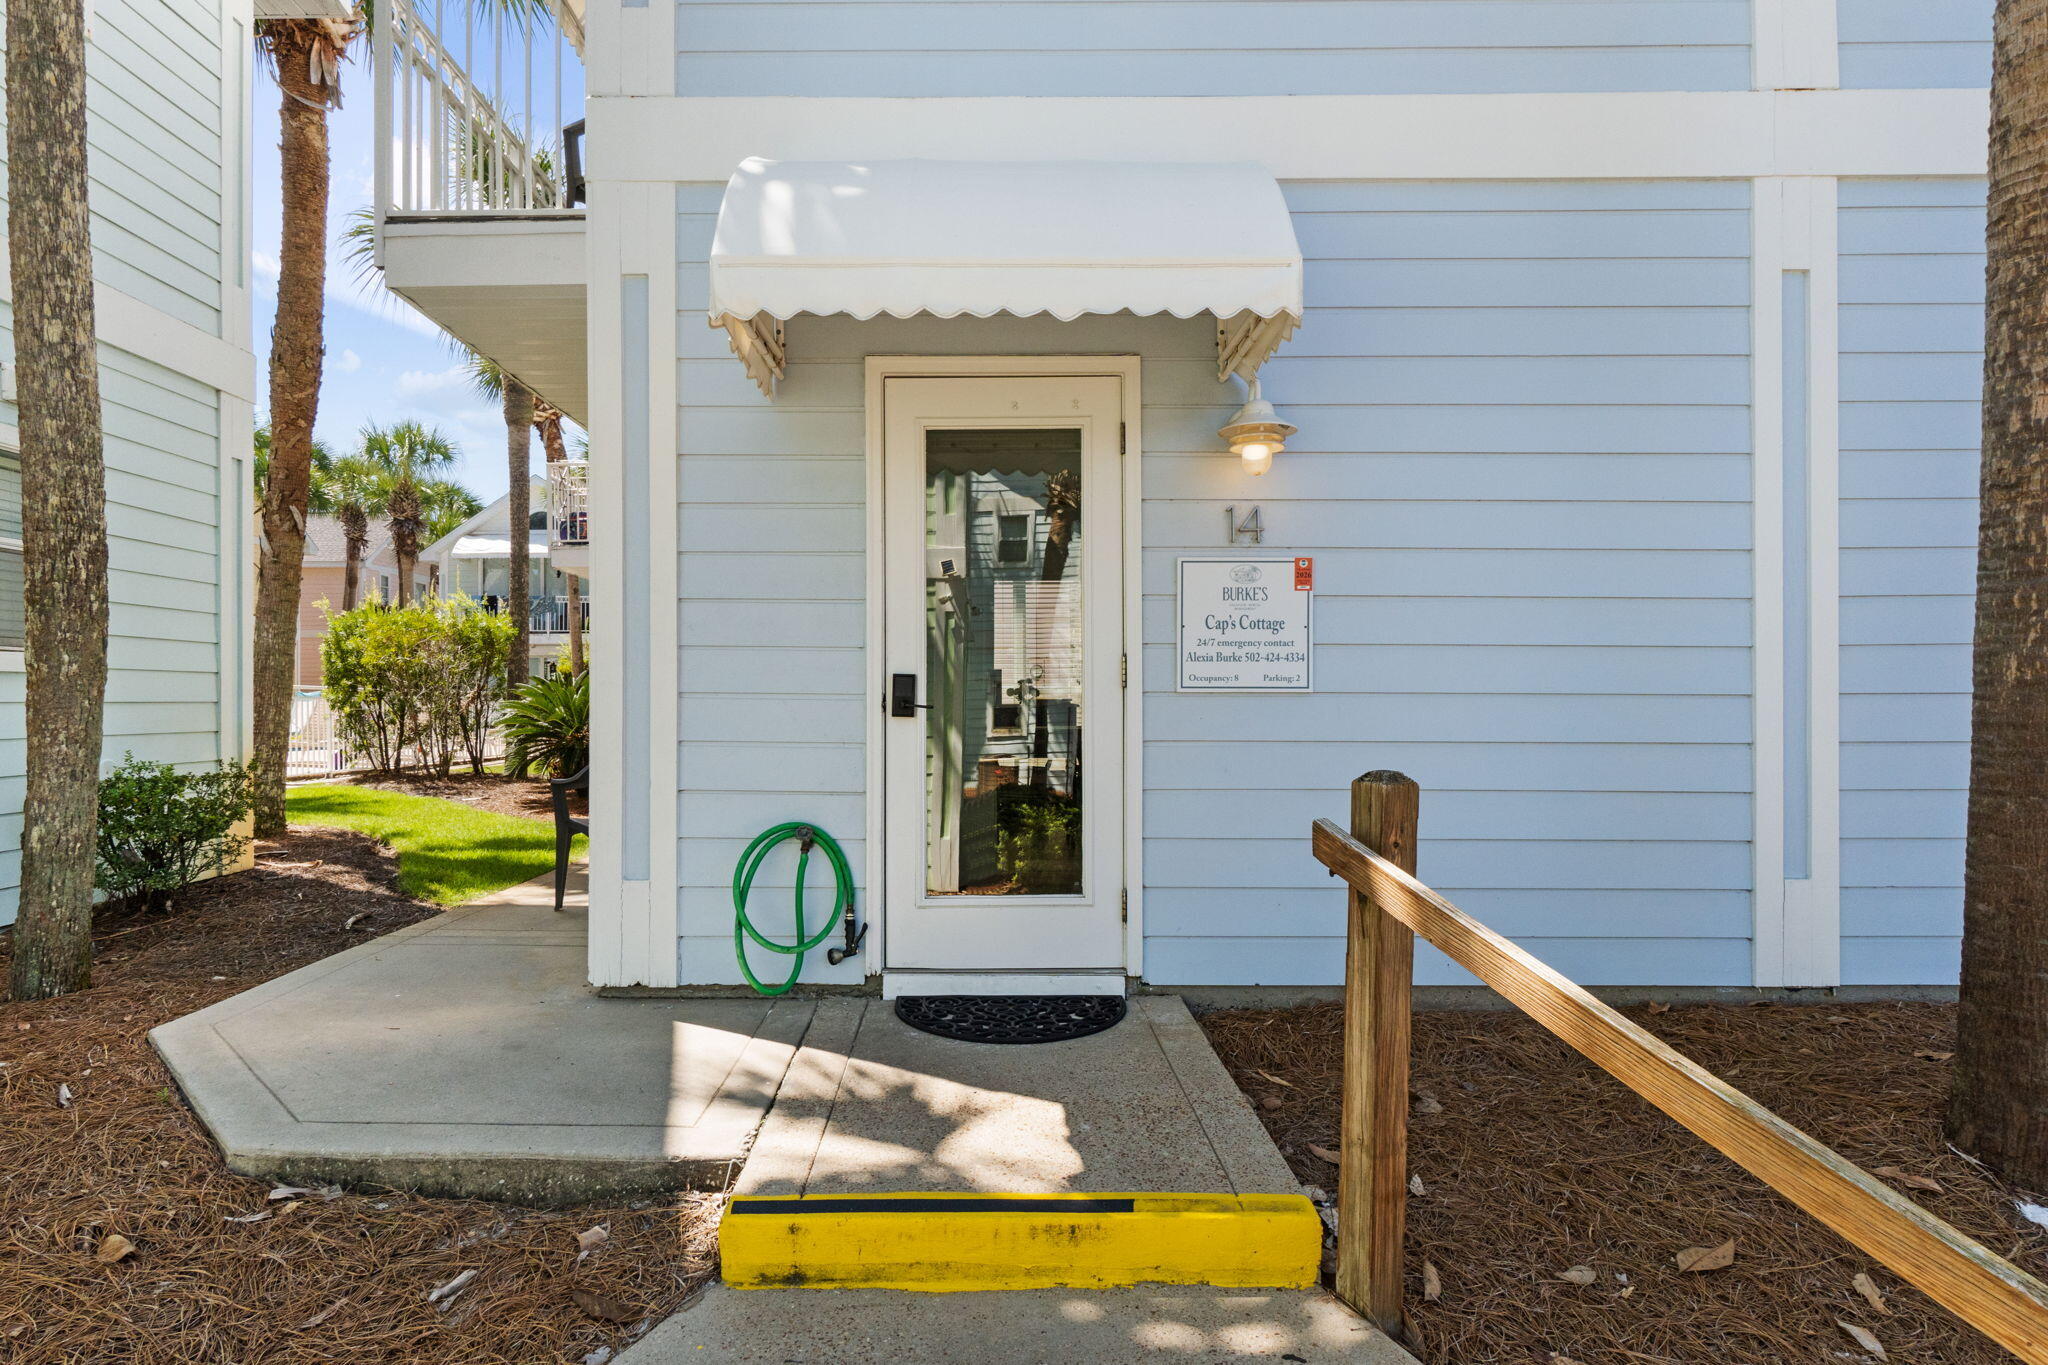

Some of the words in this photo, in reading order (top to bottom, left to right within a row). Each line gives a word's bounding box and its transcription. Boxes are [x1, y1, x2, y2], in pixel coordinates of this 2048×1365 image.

[1225, 504, 1264, 543] 14
[1222, 586, 1269, 601] BURKE'S
[1205, 614, 1236, 635] Cap's
[1239, 614, 1286, 635] Cottage
[1196, 638, 1216, 647] 24/7
[1217, 640, 1262, 649] emergency
[1263, 639, 1295, 647] contact
[1185, 651, 1214, 662] Alexia
[1216, 651, 1243, 662] Burke
[1244, 651, 1305, 662] 502-424-4334
[1188, 674, 1234, 683] Occupancy:
[1234, 674, 1239, 682] 8
[1263, 674, 1295, 683] Parking:
[1295, 674, 1301, 682] 2
